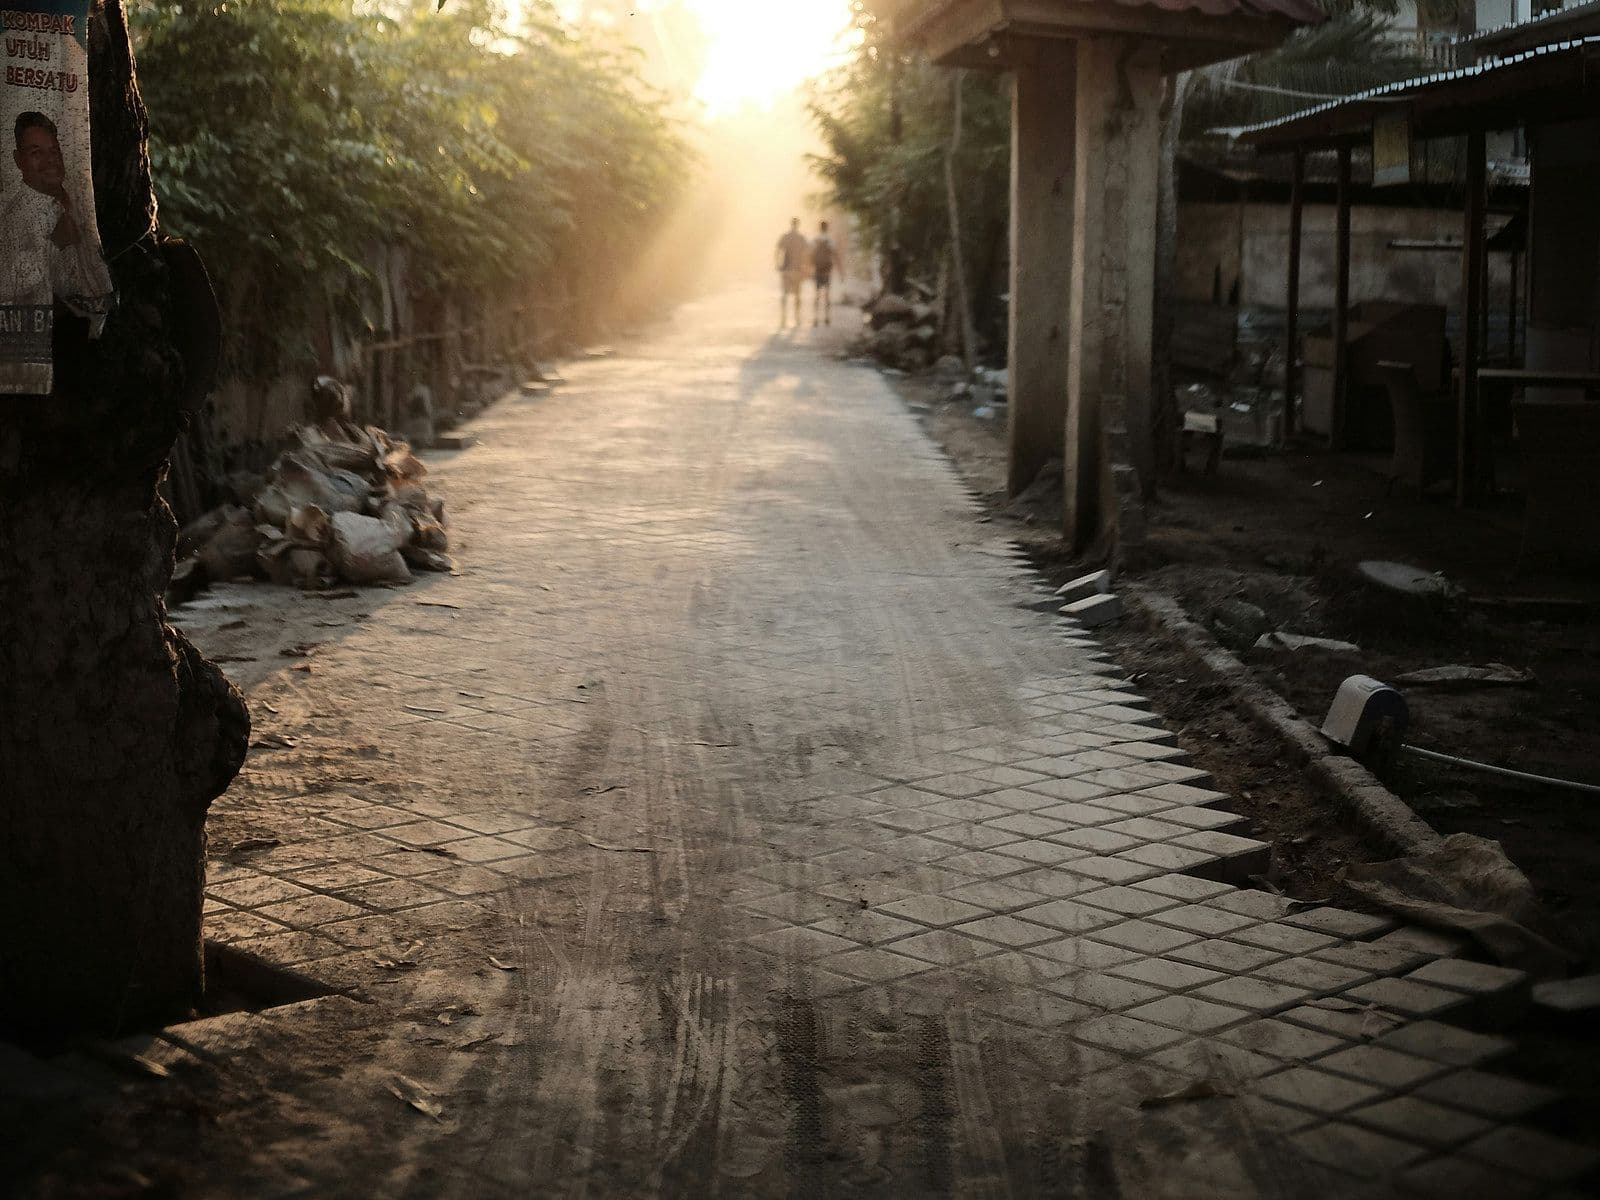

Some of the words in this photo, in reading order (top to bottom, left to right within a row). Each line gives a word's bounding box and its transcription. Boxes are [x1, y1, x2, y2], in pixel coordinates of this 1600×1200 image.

[2, 10, 75, 35] KOMPAK
[6, 38, 50, 61] UTUH
[5, 65, 78, 93] BERSATU
